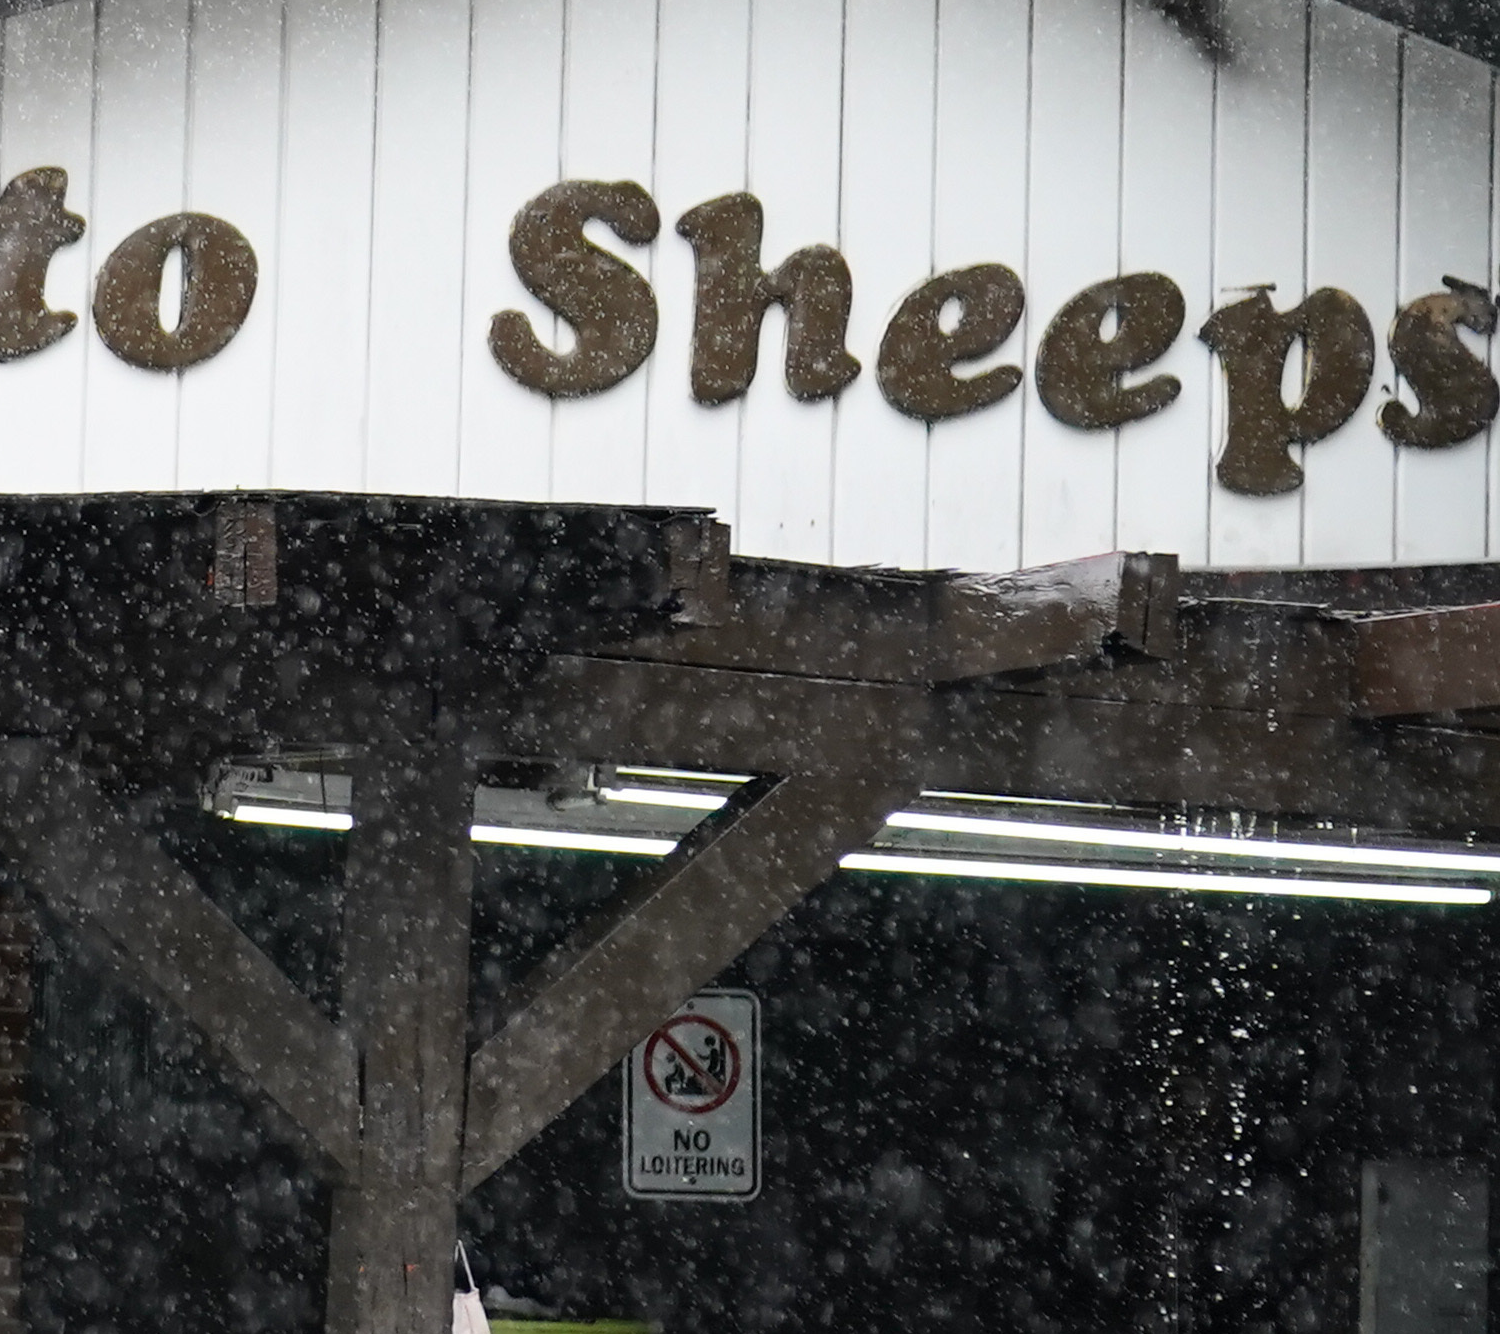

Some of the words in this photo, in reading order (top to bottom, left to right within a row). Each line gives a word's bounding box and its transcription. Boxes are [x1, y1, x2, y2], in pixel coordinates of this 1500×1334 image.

[488, 179, 1500, 495] Sheeps
[673, 1128, 711, 1152] NO
[640, 1154, 745, 1177] LOITERING
